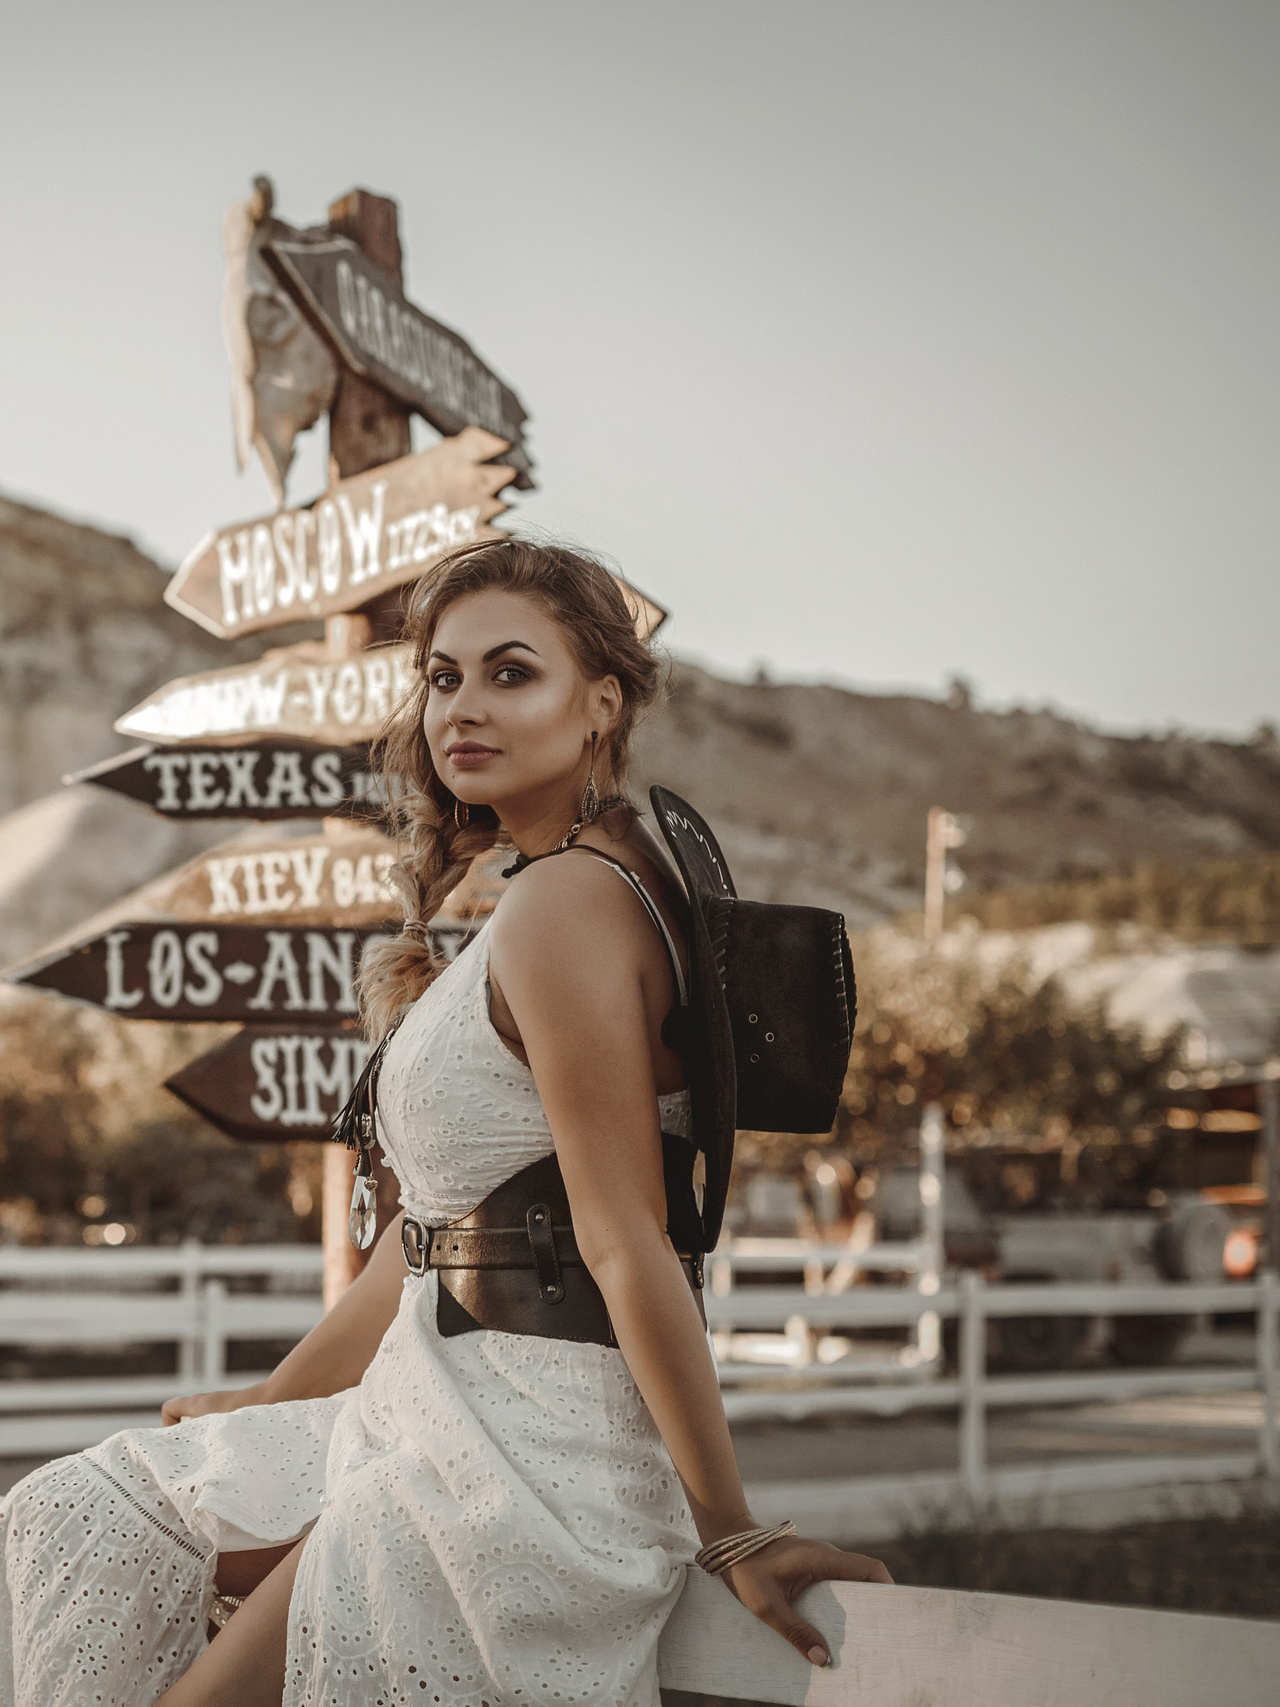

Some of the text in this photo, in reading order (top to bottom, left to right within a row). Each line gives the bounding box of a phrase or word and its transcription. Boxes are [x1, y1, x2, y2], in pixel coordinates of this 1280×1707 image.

[216, 481, 388, 627] MOSCOW
[143, 751, 345, 811] TEXAS
[206, 846, 330, 915] KIEV
